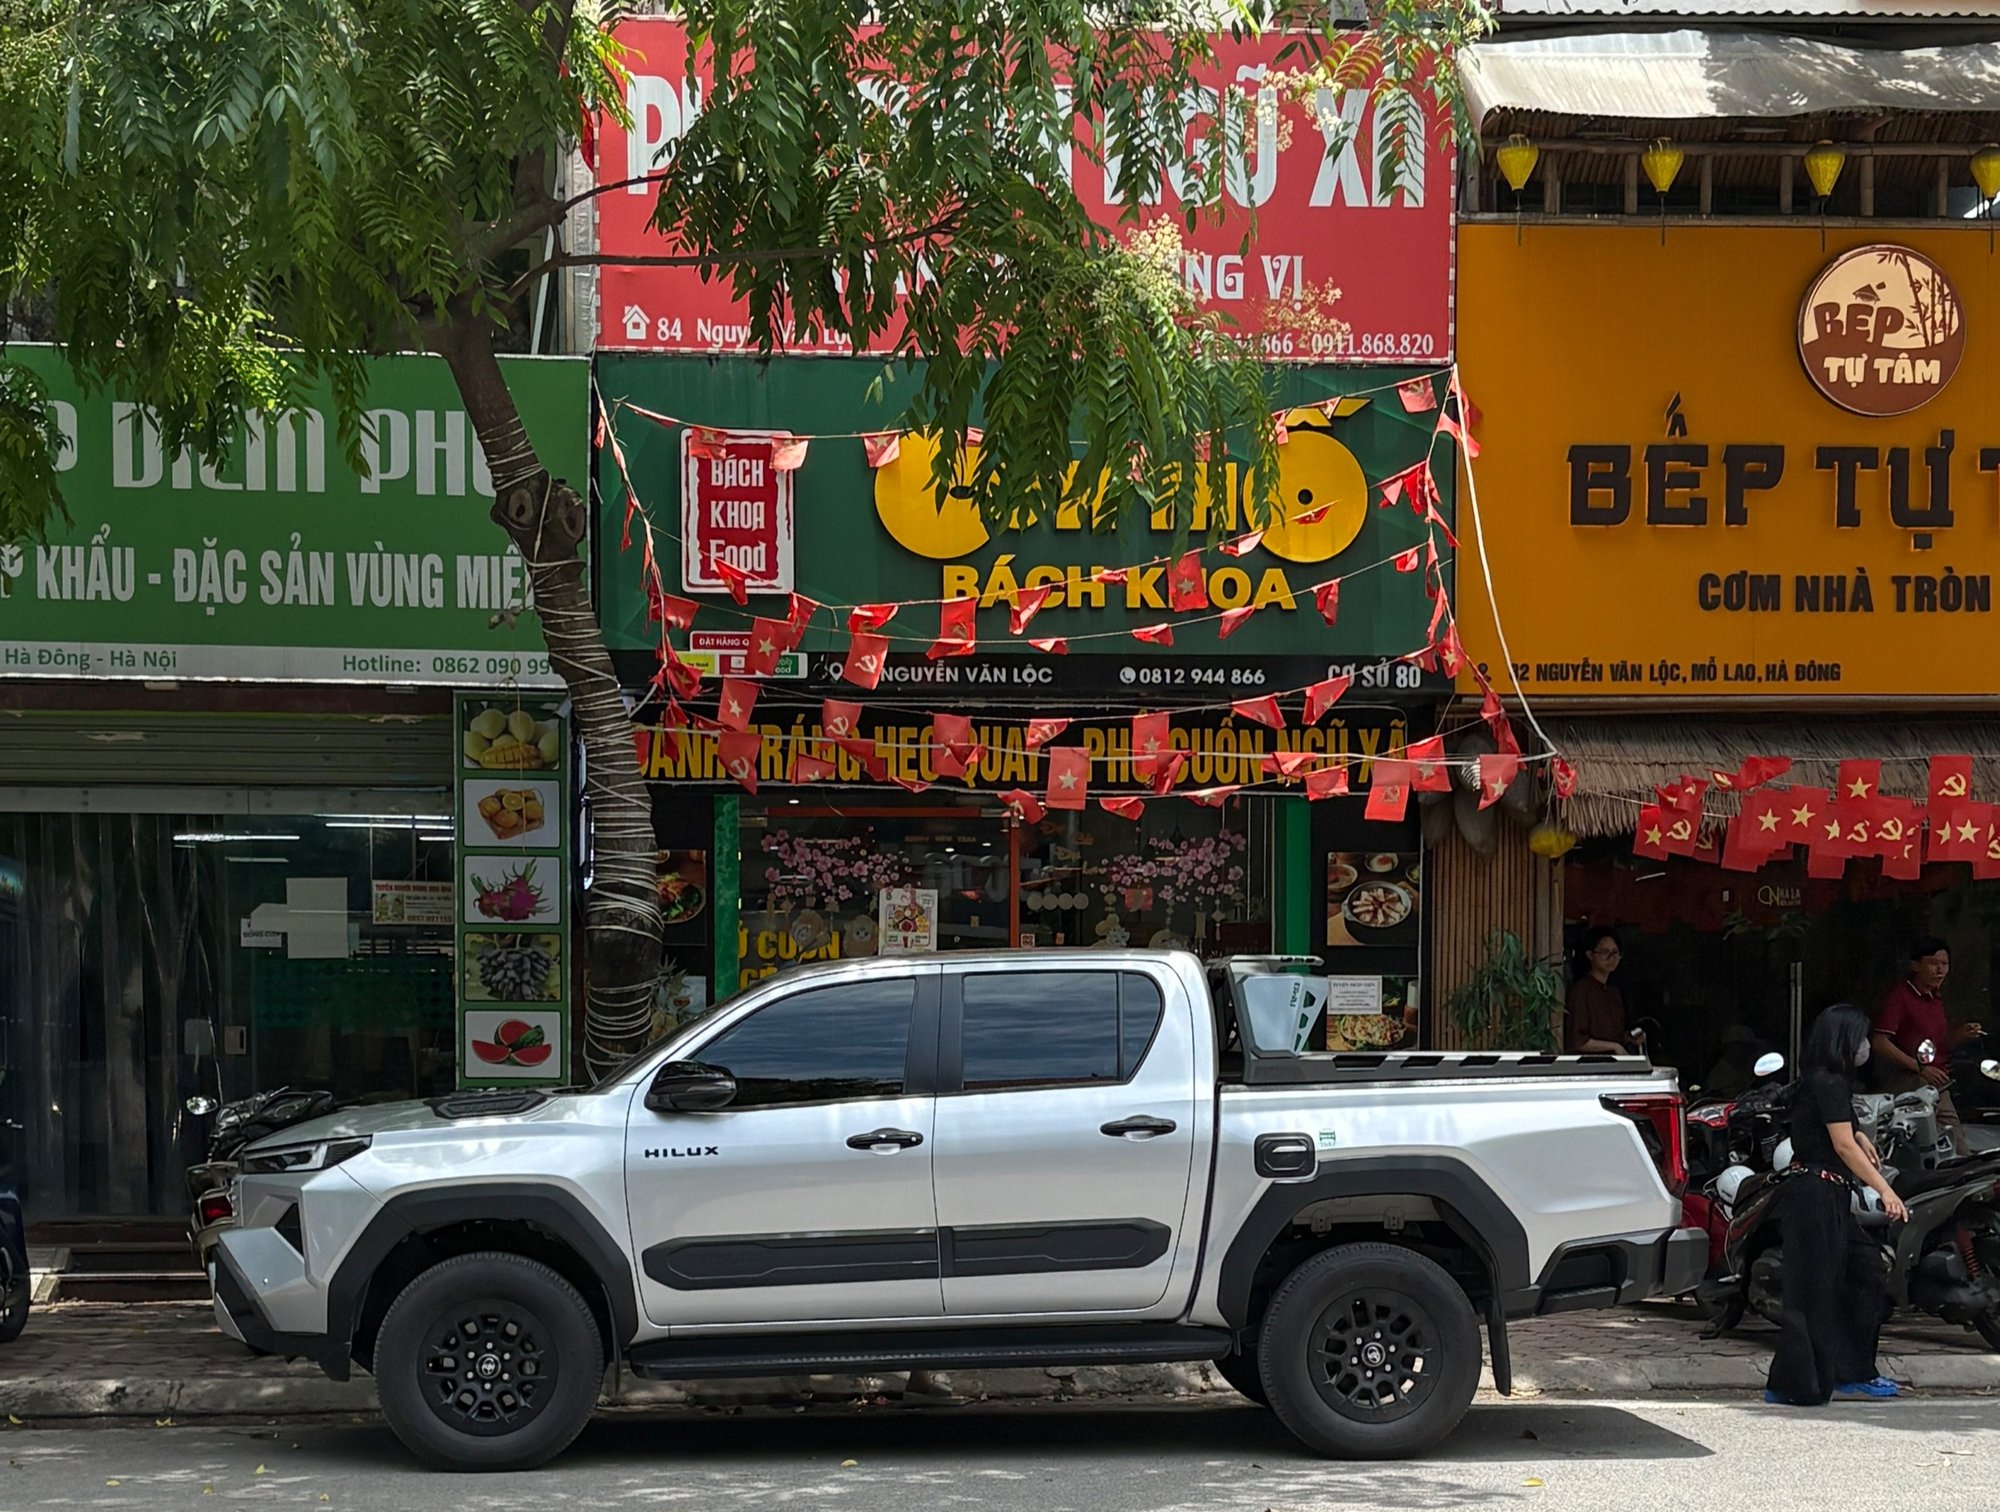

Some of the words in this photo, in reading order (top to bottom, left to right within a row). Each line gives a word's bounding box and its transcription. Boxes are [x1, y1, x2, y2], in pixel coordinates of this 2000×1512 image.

[1814, 281, 1904, 344] BẾP
[657, 317, 682, 342] 84
[1823, 353, 1868, 388] TỰ
[1873, 353, 1941, 385] TÂM
[711, 454, 764, 489] BÁCH
[1567, 391, 1785, 527] BẾP
[1814, 429, 1956, 551] TỰ
[711, 500, 764, 532] KHOA
[37, 523, 135, 602] KHẨU
[173, 536, 246, 615] ĐẶC
[260, 532, 334, 606] SẢN
[346, 541, 444, 609] VÙNG
[943, 554, 1106, 609] BÁCH
[1127, 566, 1297, 611] KOA
[1699, 570, 1781, 613] CƠM
[1795, 566, 1874, 613] NHÀ
[1892, 566, 1991, 613] TRÒN
[5, 648, 31, 665] Hà
[38, 648, 91, 671] Đông
[110, 649, 136, 667] Hà
[144, 650, 177, 671] Nội
[343, 654, 421, 673] Hotline:
[433, 656, 480, 674] 0862
[486, 657, 521, 675] 090
[527, 658, 550, 676] 99
[882, 658, 959, 683] NGUYỄN
[965, 660, 1008, 683] VĂN
[1013, 661, 1054, 686] LỘC
[1536, 657, 1604, 682] NGUYỄN
[1610, 660, 1642, 682] VĂN
[1795, 660, 1841, 682] ĐÔNG
[1140, 667, 1185, 685] 0812
[1189, 667, 1226, 685] 944
[1230, 667, 1266, 686] 866
[1396, 665, 1422, 689] 80
[641, 711, 726, 779] ÁNH
[757, 929, 840, 960] CUN
[644, 1145, 719, 1159] HILUX
